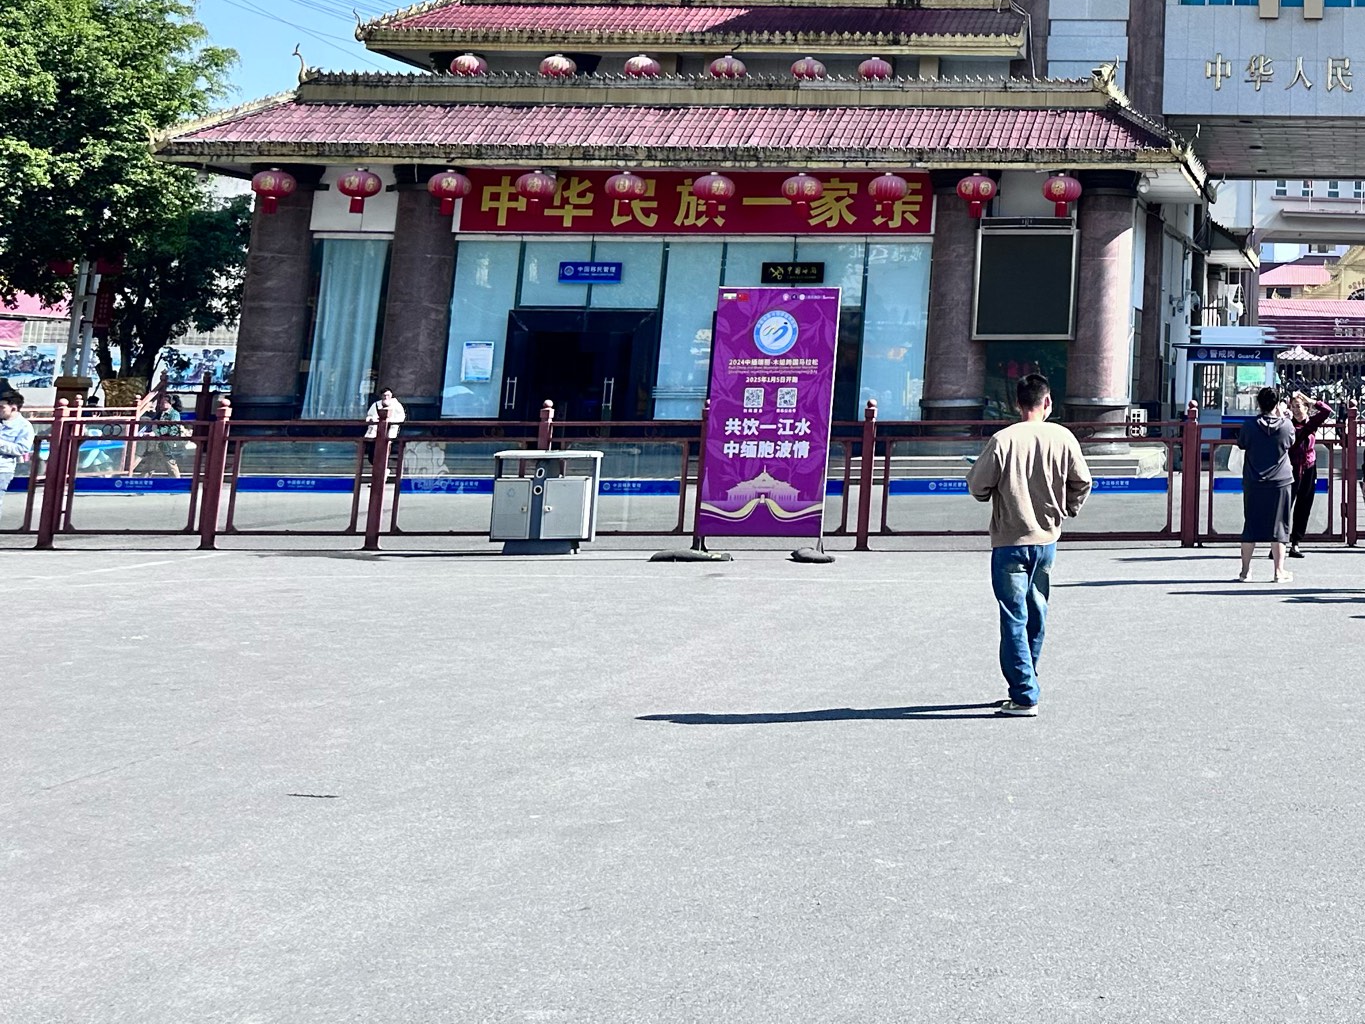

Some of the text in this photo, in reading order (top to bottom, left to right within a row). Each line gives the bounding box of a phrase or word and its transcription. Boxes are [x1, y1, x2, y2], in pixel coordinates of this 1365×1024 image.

[480, 175, 924, 229] 中华民族一家亲
[577, 265, 616, 273] 中国移民管理
[1255, 350, 1261, 359] 2
[724, 418, 811, 436] 共饮一江水
[723, 440, 810, 459] 中缅胞波情
